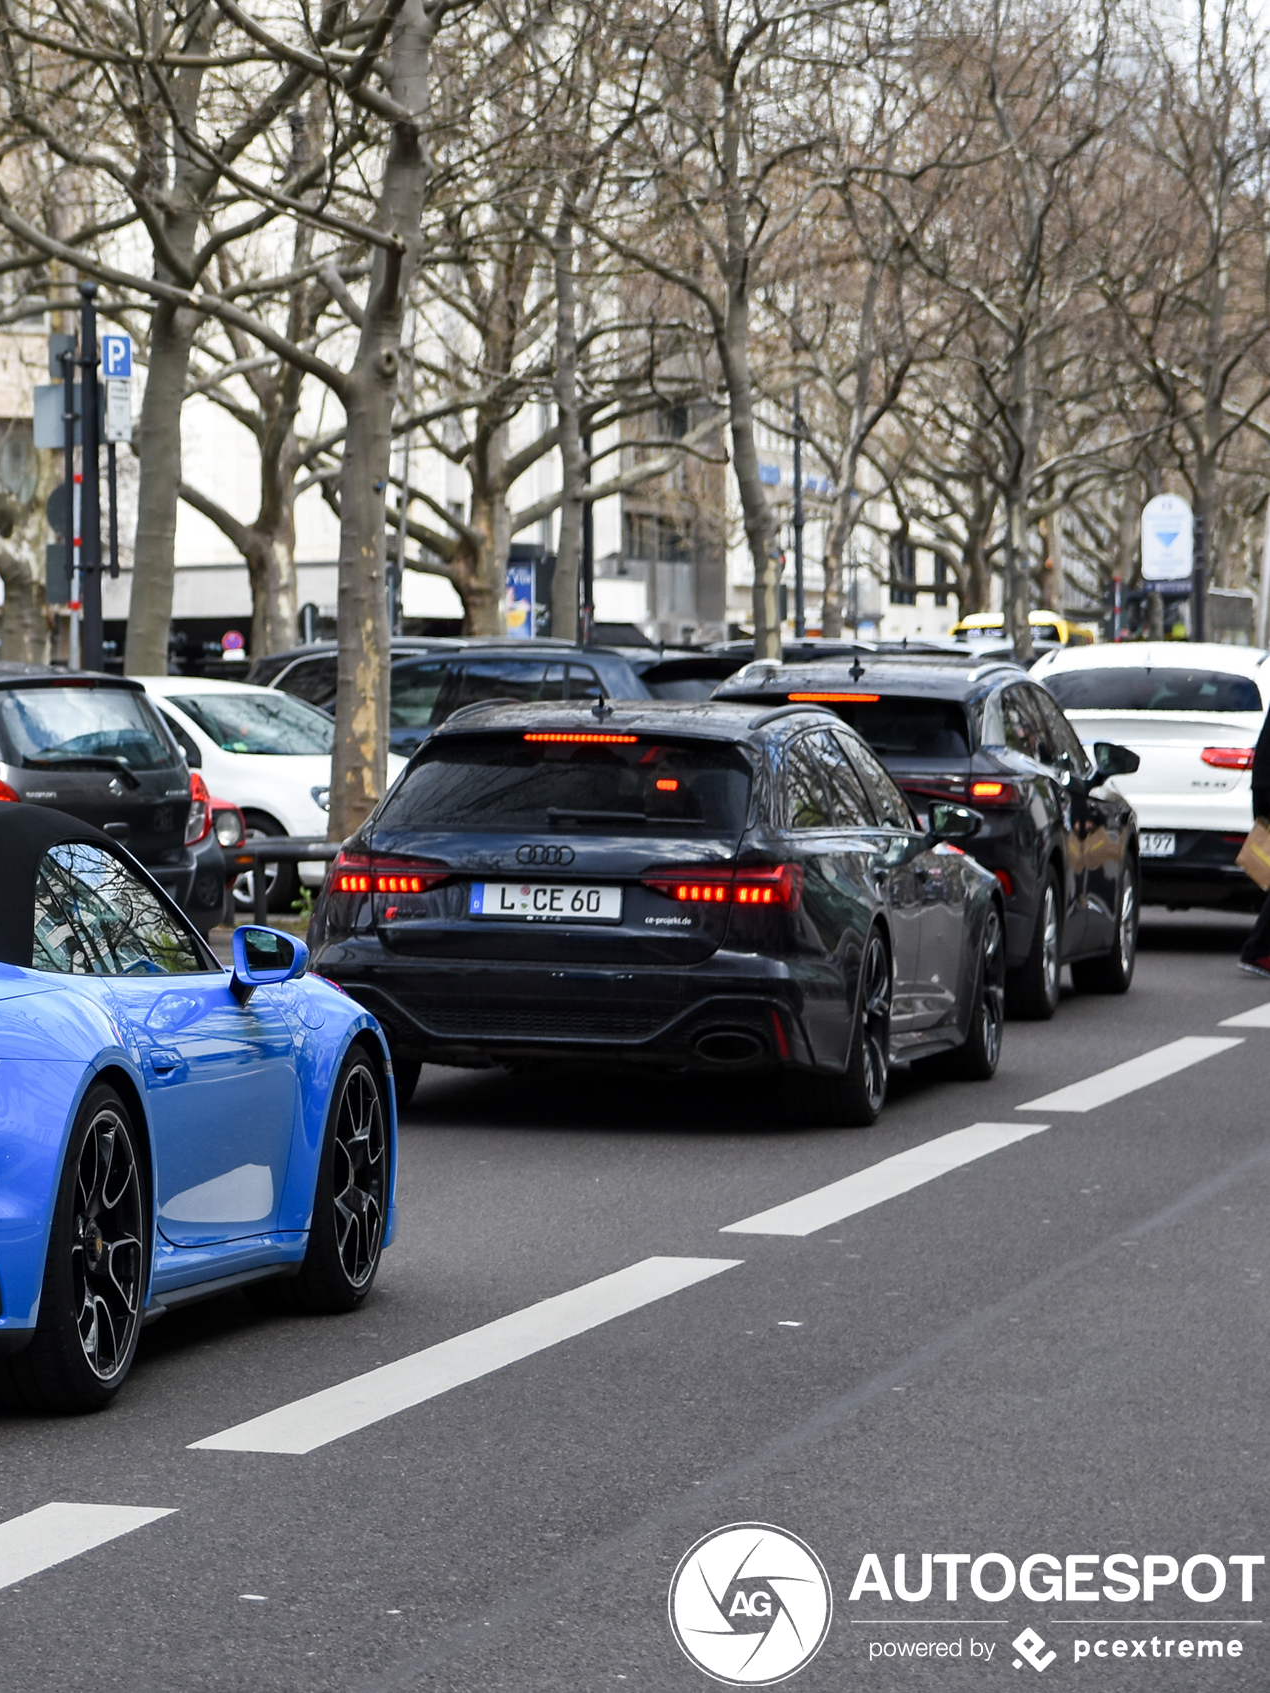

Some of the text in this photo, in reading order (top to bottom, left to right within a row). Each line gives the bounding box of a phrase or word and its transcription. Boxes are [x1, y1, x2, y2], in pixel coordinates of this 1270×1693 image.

[108, 339, 126, 374] P
[1143, 834, 1172, 852] 197
[473, 887, 601, 913] D L CE 60
